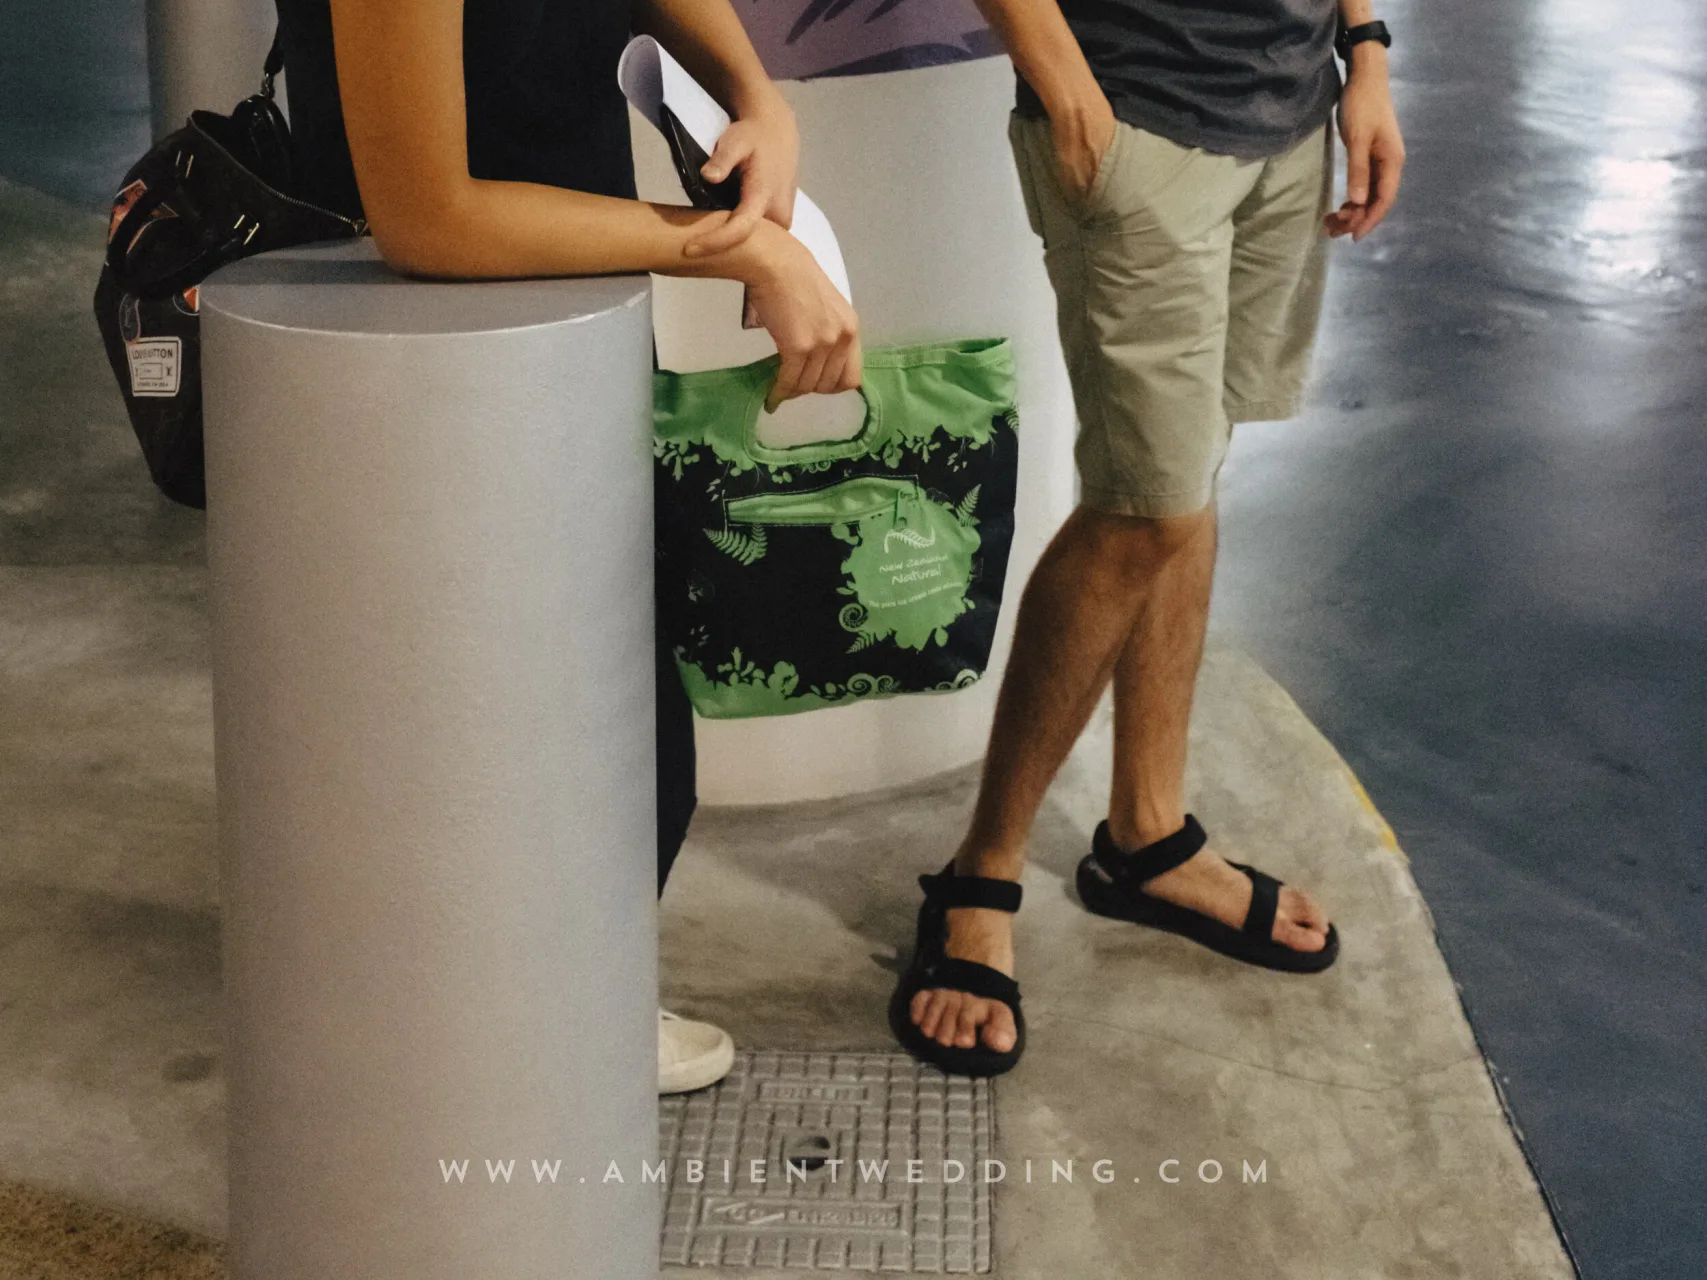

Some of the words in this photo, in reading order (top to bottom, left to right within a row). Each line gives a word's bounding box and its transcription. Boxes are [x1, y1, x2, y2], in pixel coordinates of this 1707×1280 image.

[879, 561, 903, 573] New
[906, 553, 949, 568] Zealand
[892, 563, 941, 585] Natural
